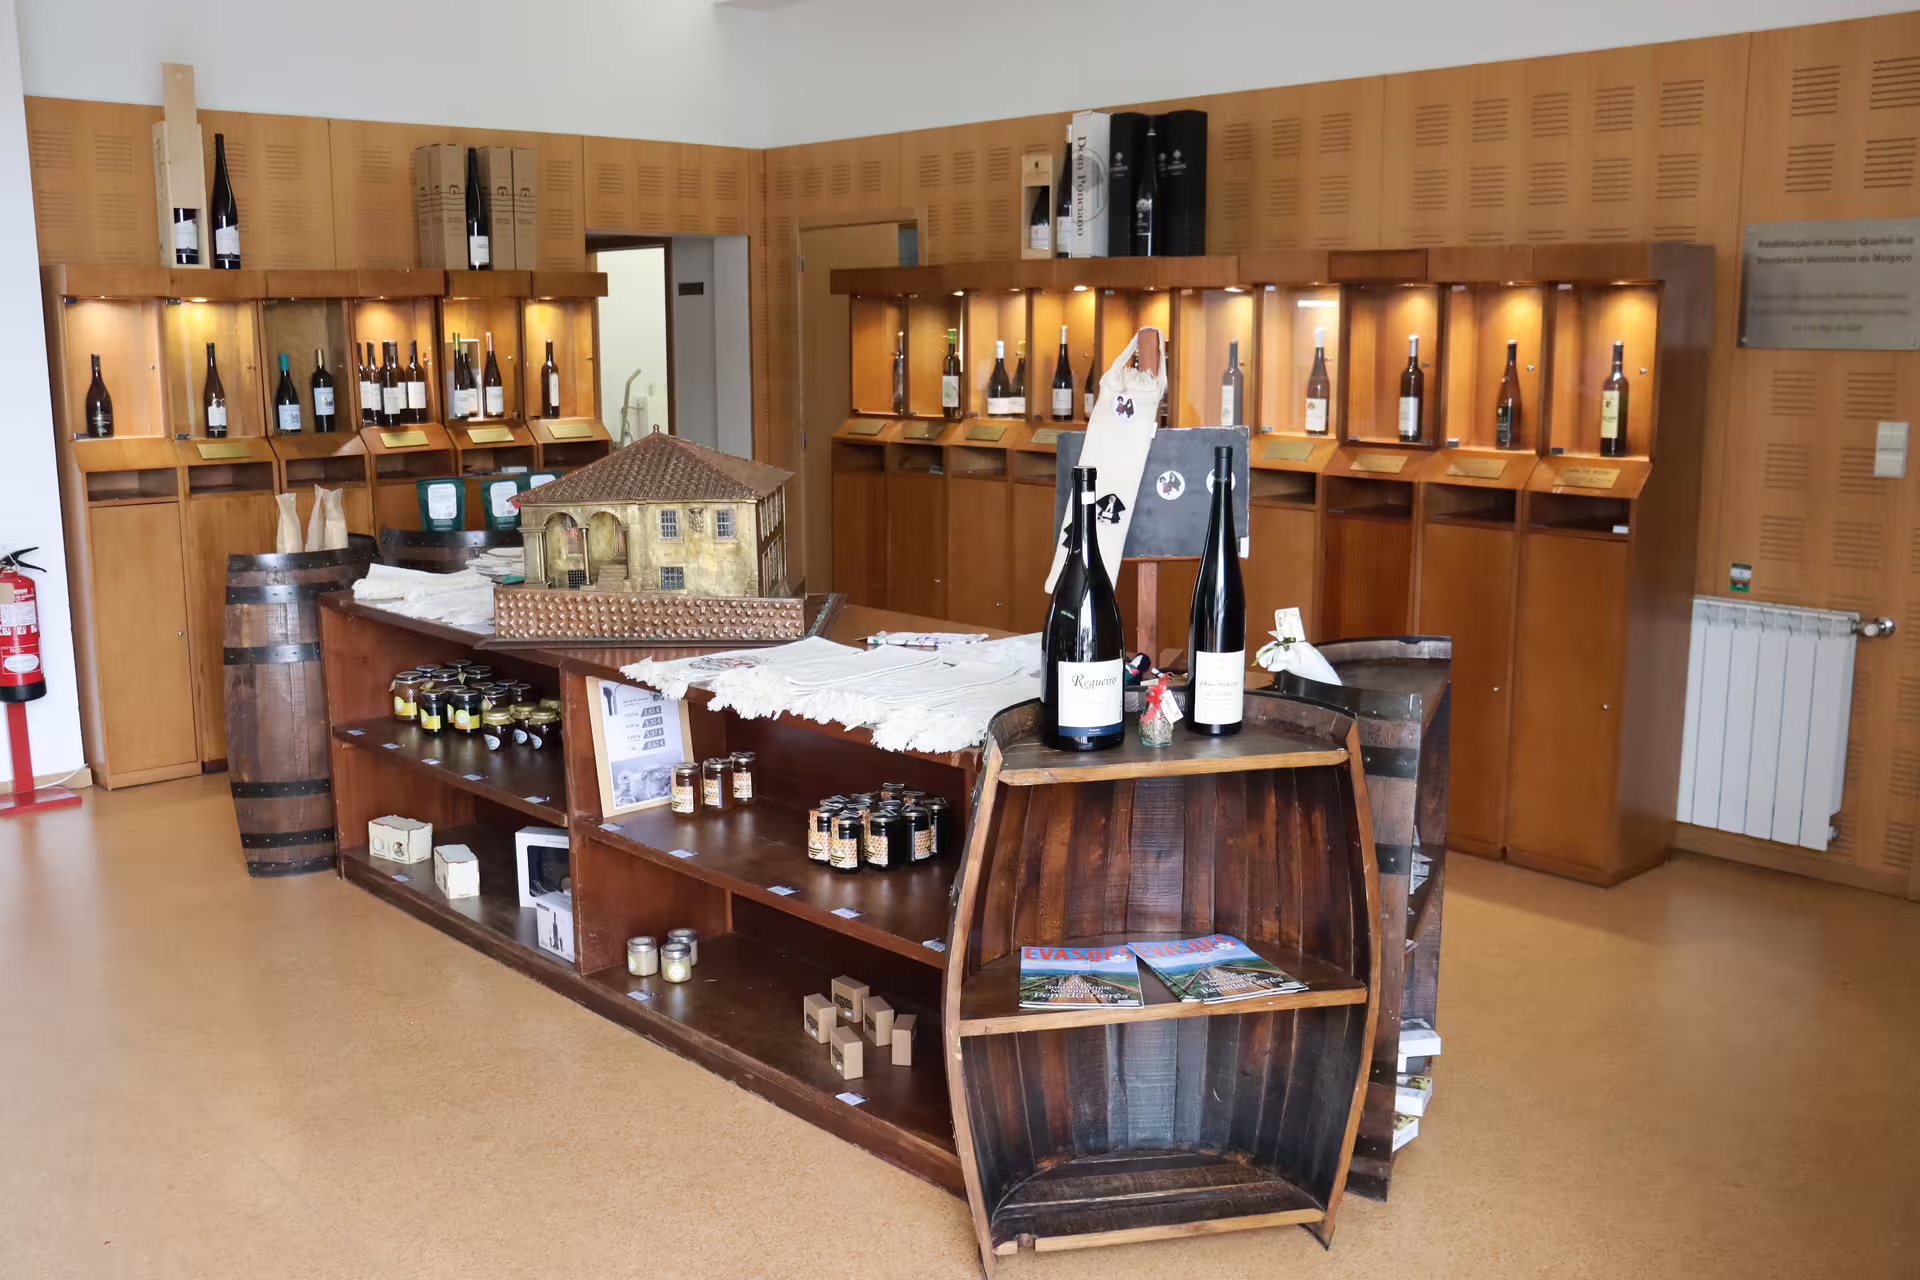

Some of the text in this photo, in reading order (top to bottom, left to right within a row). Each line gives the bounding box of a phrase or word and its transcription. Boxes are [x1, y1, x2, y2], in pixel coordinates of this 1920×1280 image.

[1077, 136, 1087, 237] Dom Ponciano
[1873, 252, 1913, 264] Melgaço
